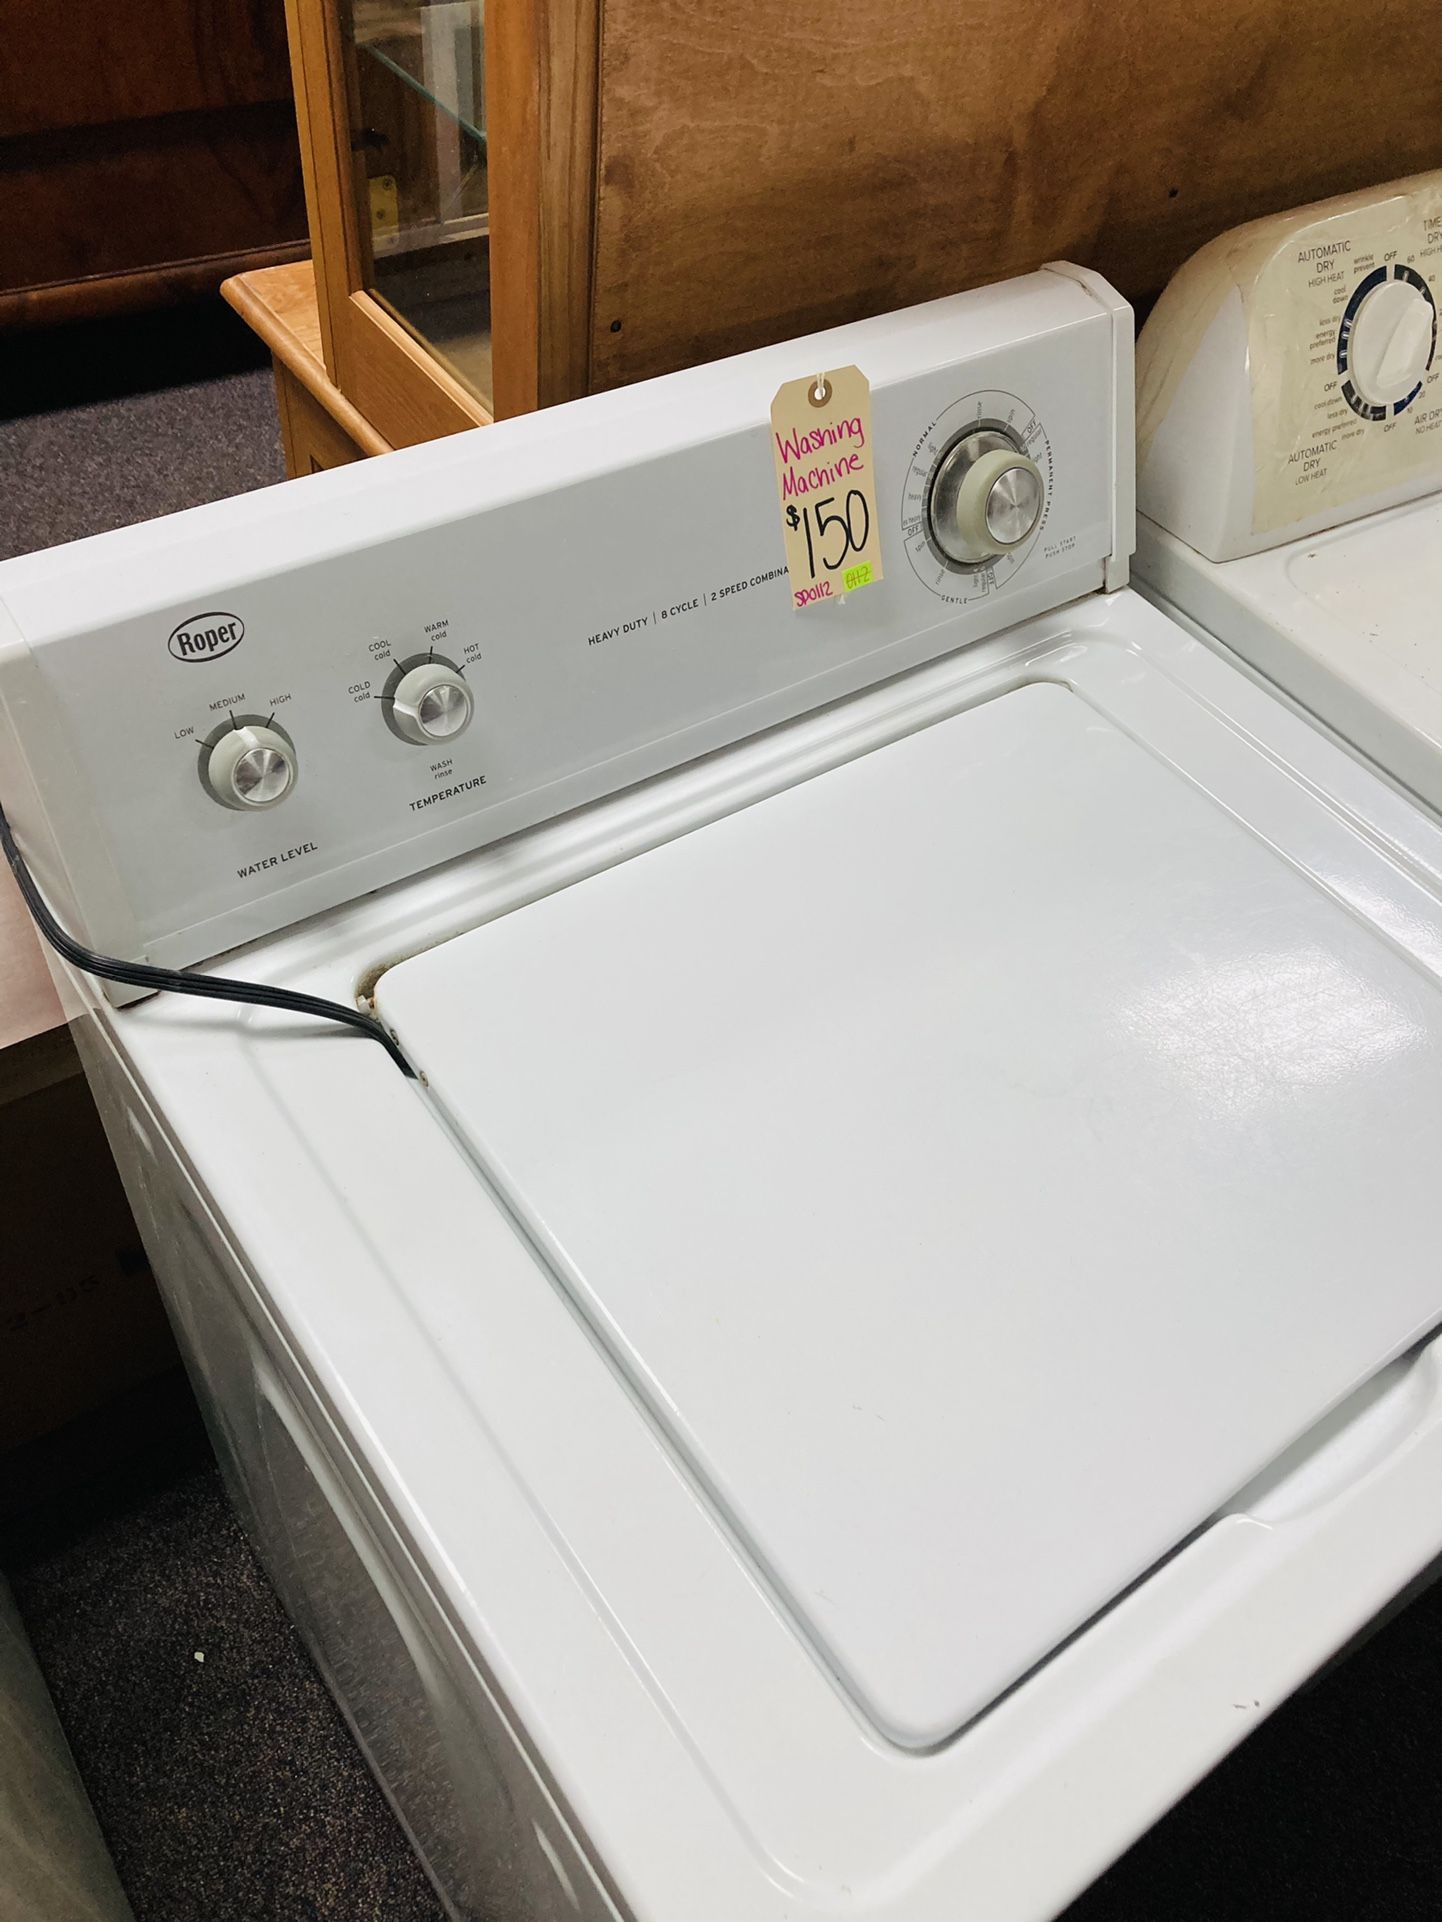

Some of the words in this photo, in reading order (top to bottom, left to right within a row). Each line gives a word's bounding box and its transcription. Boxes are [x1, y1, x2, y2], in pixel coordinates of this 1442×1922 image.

[1297, 240, 1352, 263] AUTOMATIC
[1383, 250, 1398, 262] OFF
[1316, 258, 1335, 273] DRY
[1308, 275, 1327, 288] HIGH
[1327, 271, 1345, 283] HEAT
[1426, 373, 1440, 384] OFF
[1323, 380, 1338, 393] OFF
[1414, 412, 1428, 425] AIR
[1026, 420, 1038, 434] OFF
[1383, 422, 1397, 433] OFF
[775, 416, 865, 464] Washing
[912, 421, 938, 458] NORMAL
[1287, 440, 1338, 465] AUTOMATIC
[1303, 457, 1321, 472] DRY
[782, 452, 865, 500] Machine
[1295, 473, 1310, 486] LOW
[1310, 467, 1328, 480] HEAT
[786, 489, 869, 579] $150
[907, 525, 919, 536] OFF
[588, 627, 620, 646] HEAVY
[623, 616, 649, 634] DUTY
[661, 609, 668, 620] 8
[669, 598, 699, 616] CYCLE
[711, 592, 718, 602] 2
[719, 581, 749, 599] SPEED
[423, 619, 450, 635] WARM
[176, 621, 238, 656] Roper
[430, 630, 448, 642] cold
[368, 639, 392, 653] COOL
[463, 643, 481, 655] HOT
[374, 649, 391, 661] cold
[466, 652, 483, 664] cold
[347, 681, 372, 695] COLD
[208, 693, 246, 711] MEDIUM
[269, 693, 292, 707] HIGH
[353, 691, 371, 704] cold
[174, 726, 195, 740] LOW
[429, 758, 453, 773] WASH
[434, 768, 453, 780] rinse
[408, 775, 488, 812] TEMPERATURE
[236, 855, 278, 879] WATER
[280, 841, 318, 862] LEVEL
